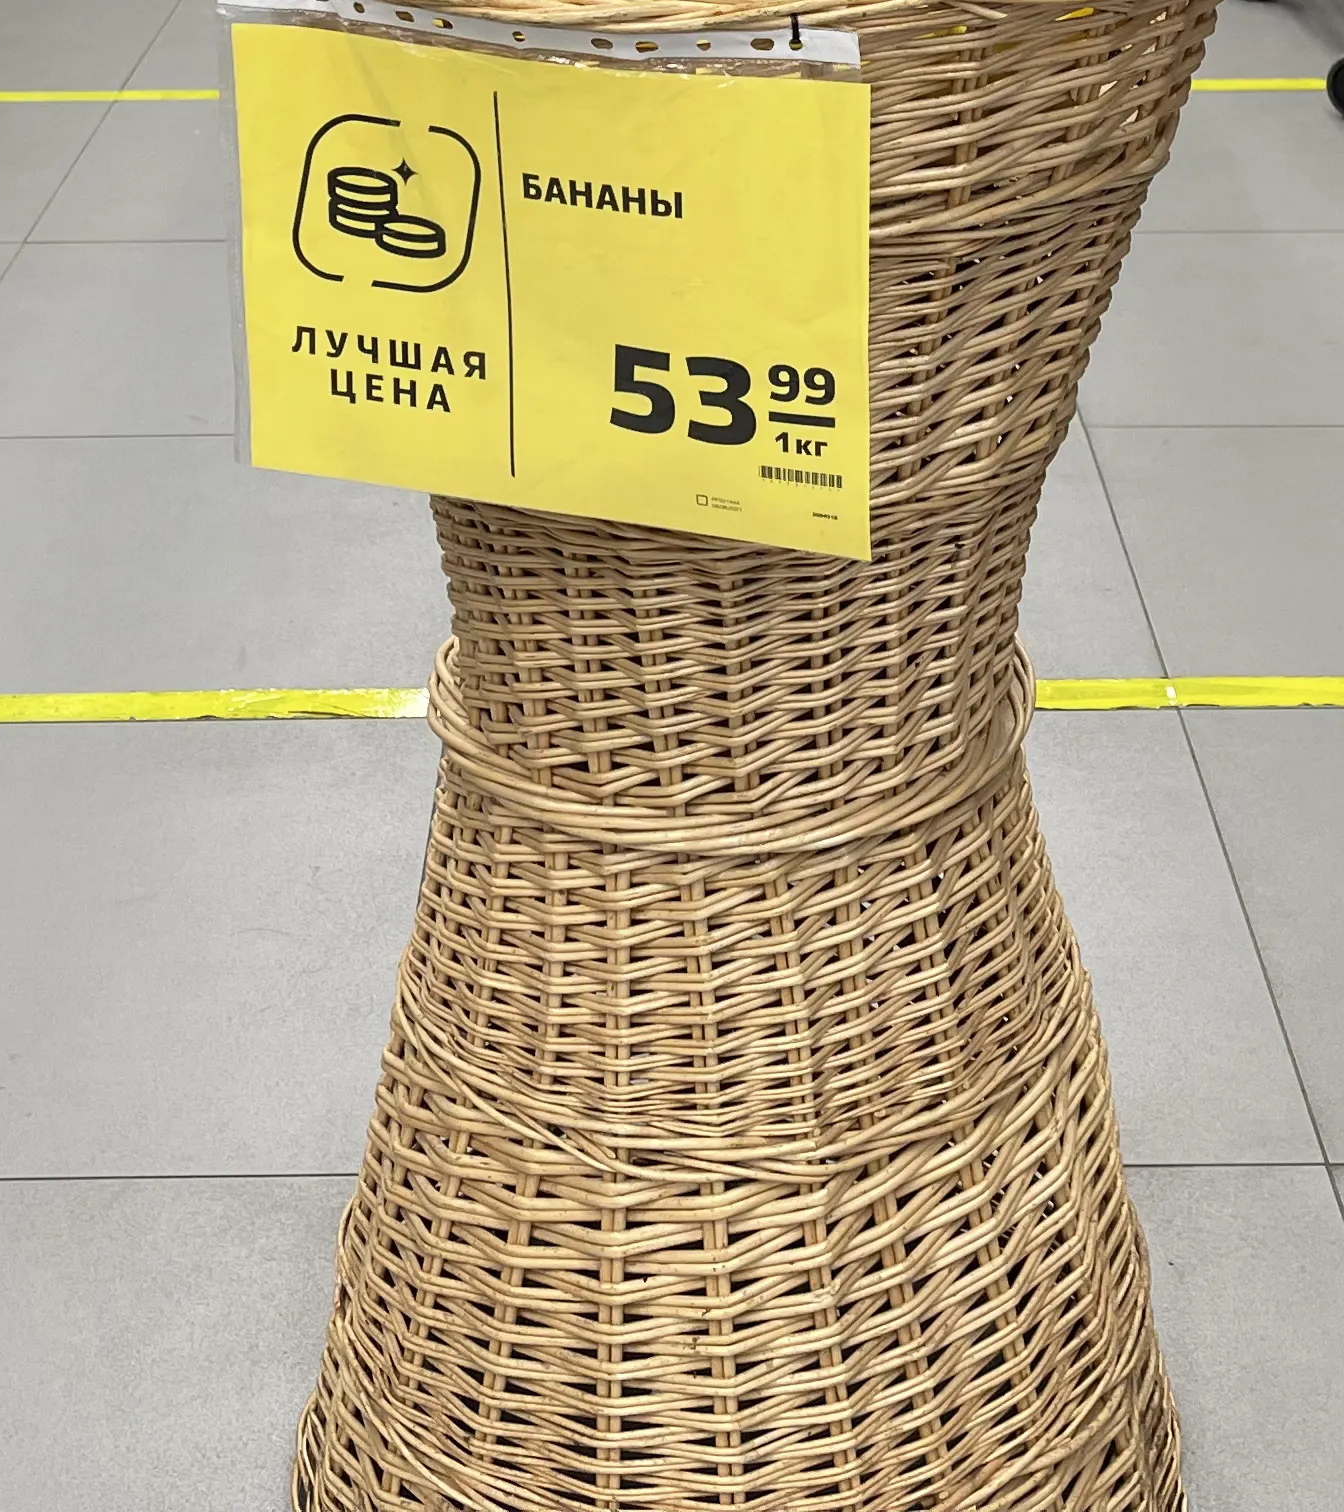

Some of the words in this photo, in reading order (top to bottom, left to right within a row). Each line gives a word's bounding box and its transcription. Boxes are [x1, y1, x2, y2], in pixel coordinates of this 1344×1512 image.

[521, 172, 685, 220] БАНАНЫ
[291, 325, 488, 381] ЛУЧШАЯ
[330, 370, 452, 414] ЦЕНА
[608, 345, 757, 447] 53
[767, 364, 837, 407] 99
[773, 431, 829, 459] 1кг
